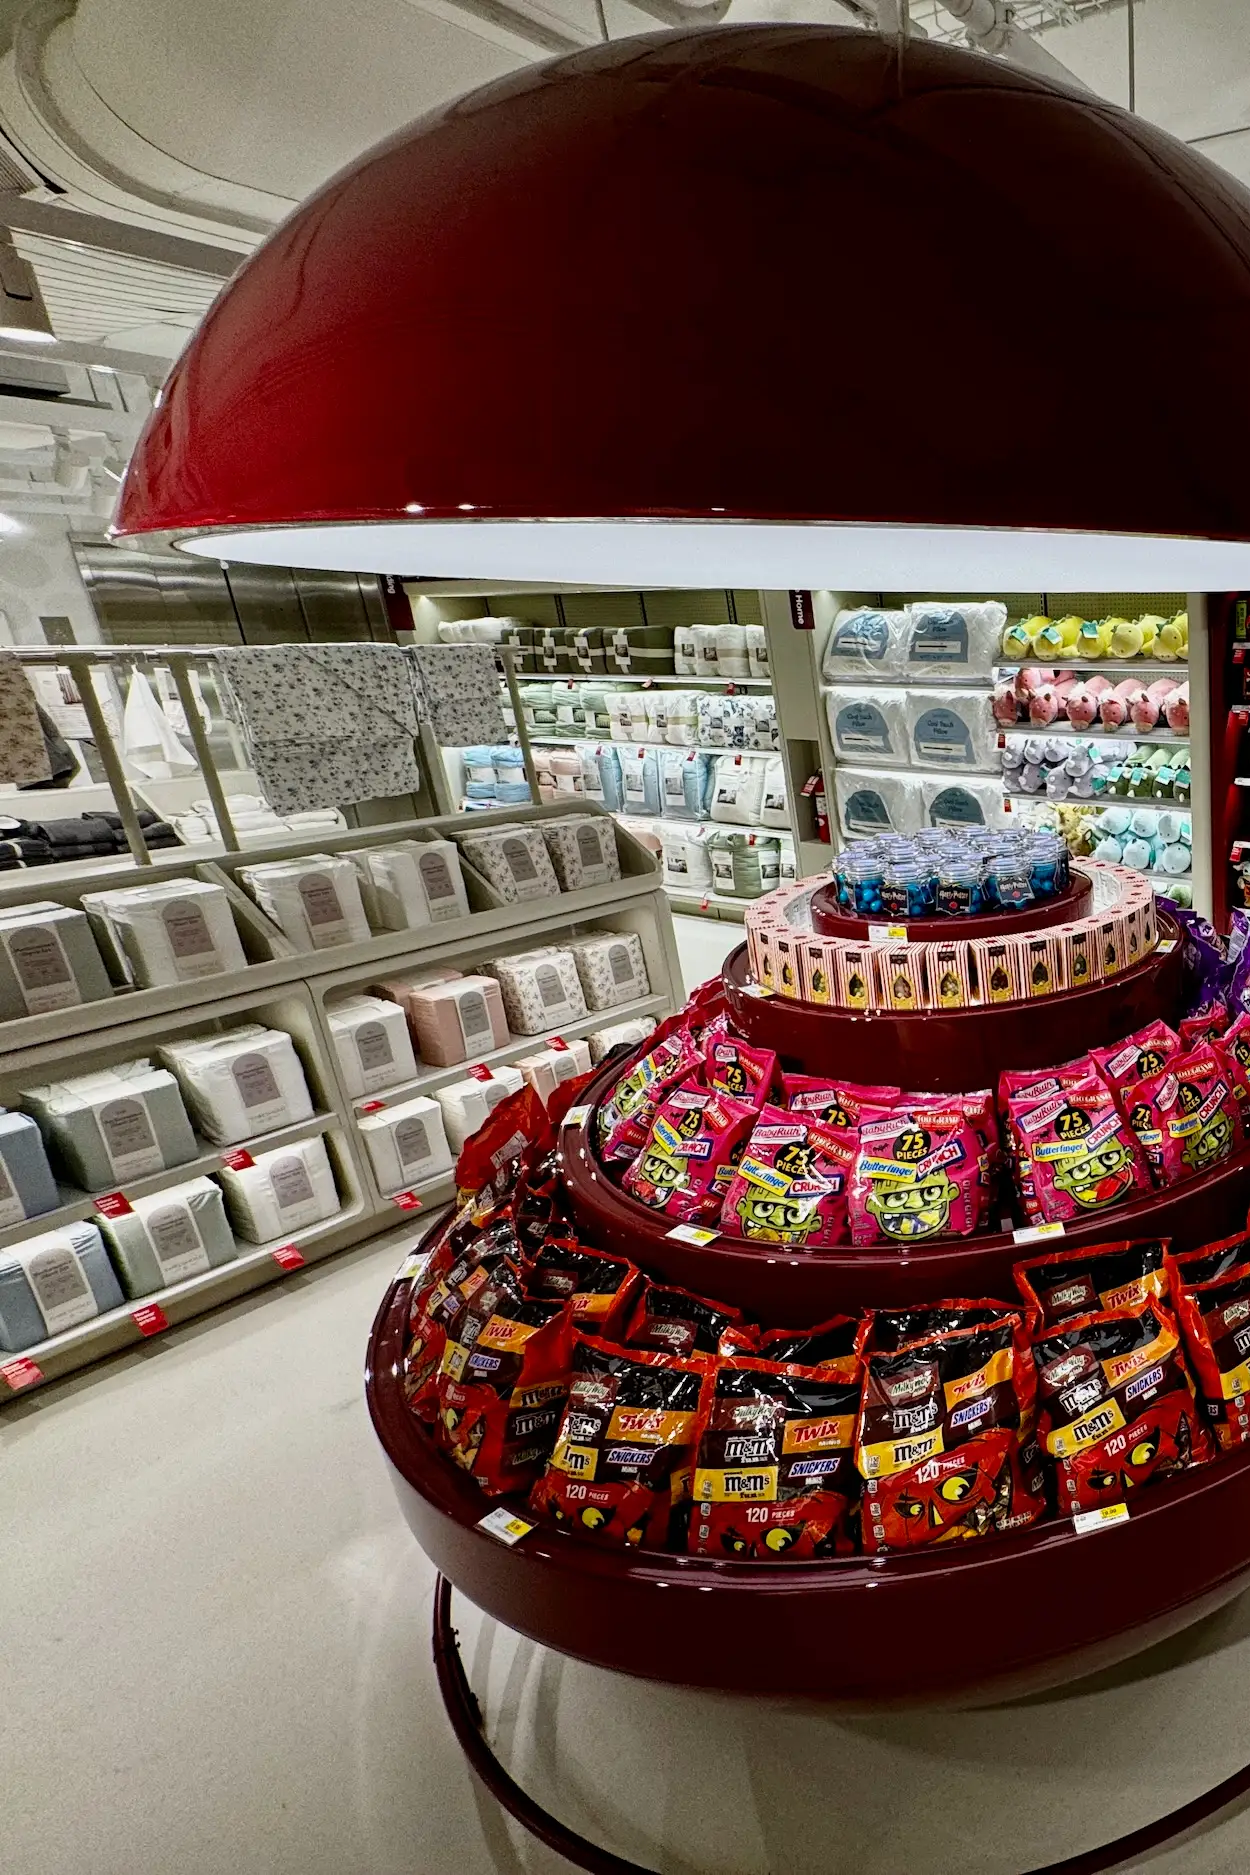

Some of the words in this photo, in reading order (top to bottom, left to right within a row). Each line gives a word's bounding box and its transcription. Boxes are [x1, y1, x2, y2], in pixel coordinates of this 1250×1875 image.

[795, 595, 805, 625] Home
[1140, 1055, 1159, 1072] 75
[726, 1066, 742, 1083] 75
[1199, 1087, 1225, 1120] CRUNCH
[684, 1109, 700, 1126] 75
[828, 1109, 848, 1126] 75
[1060, 1112, 1084, 1131] 75
[1060, 1124, 1092, 1140] PIECES
[1087, 1116, 1122, 1144] CRUNCH
[902, 1133, 925, 1151] 75
[1035, 1142, 1084, 1157] Butterfinger
[785, 1146, 809, 1165] 75
[896, 1147, 928, 1160] PIECES
[776, 1160, 811, 1175] PIECES
[860, 1160, 915, 1176] Butterfinger
[1107, 1283, 1141, 1309] Twix
[485, 1321, 517, 1339] Twix
[1111, 1351, 1146, 1378] Twix
[953, 1370, 987, 1397] Twix
[1126, 1367, 1163, 1401] SNICKERS
[952, 1398, 992, 1428] SNICKERS
[618, 1413, 667, 1432] Twix
[793, 1420, 839, 1443] Twix
[1104, 1434, 1126, 1457] 120
[606, 1448, 656, 1466] SNICKERS
[789, 1457, 841, 1478] SNICKERS
[915, 1460, 941, 1484] 120
[565, 1484, 588, 1500] 120
[588, 1491, 610, 1501] PIECES
[745, 1507, 769, 1523] 120
[771, 1509, 796, 1519] PIECES
